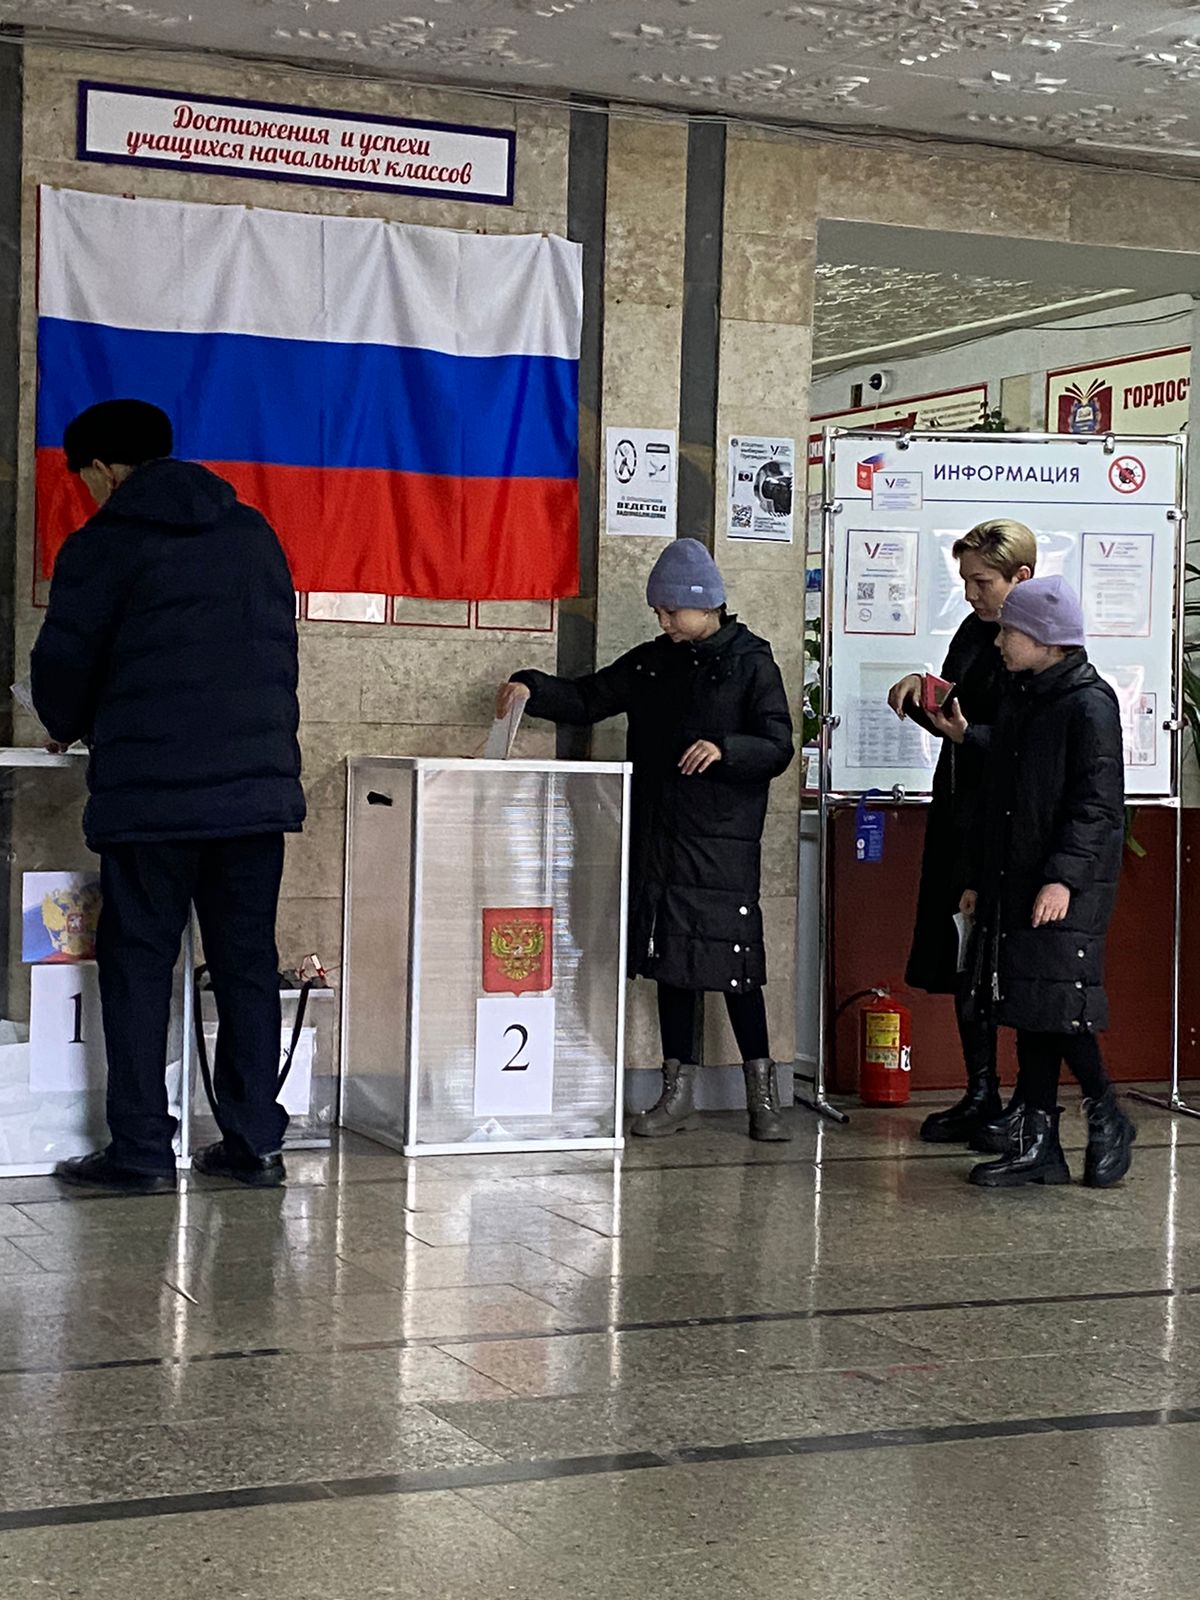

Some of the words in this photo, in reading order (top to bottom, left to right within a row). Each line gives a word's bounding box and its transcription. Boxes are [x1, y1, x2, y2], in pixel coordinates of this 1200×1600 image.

[173, 104, 329, 145] Достижения
[341, 131, 355, 149] и
[359, 132, 431, 157] успехи
[127, 129, 244, 162] учащихся
[249, 147, 380, 176] начальных
[384, 159, 473, 185] классов
[933, 463, 1080, 484] ИНФОРМАЦИЯ
[69, 992, 85, 1043] 1
[501, 1023, 530, 1072] 2
